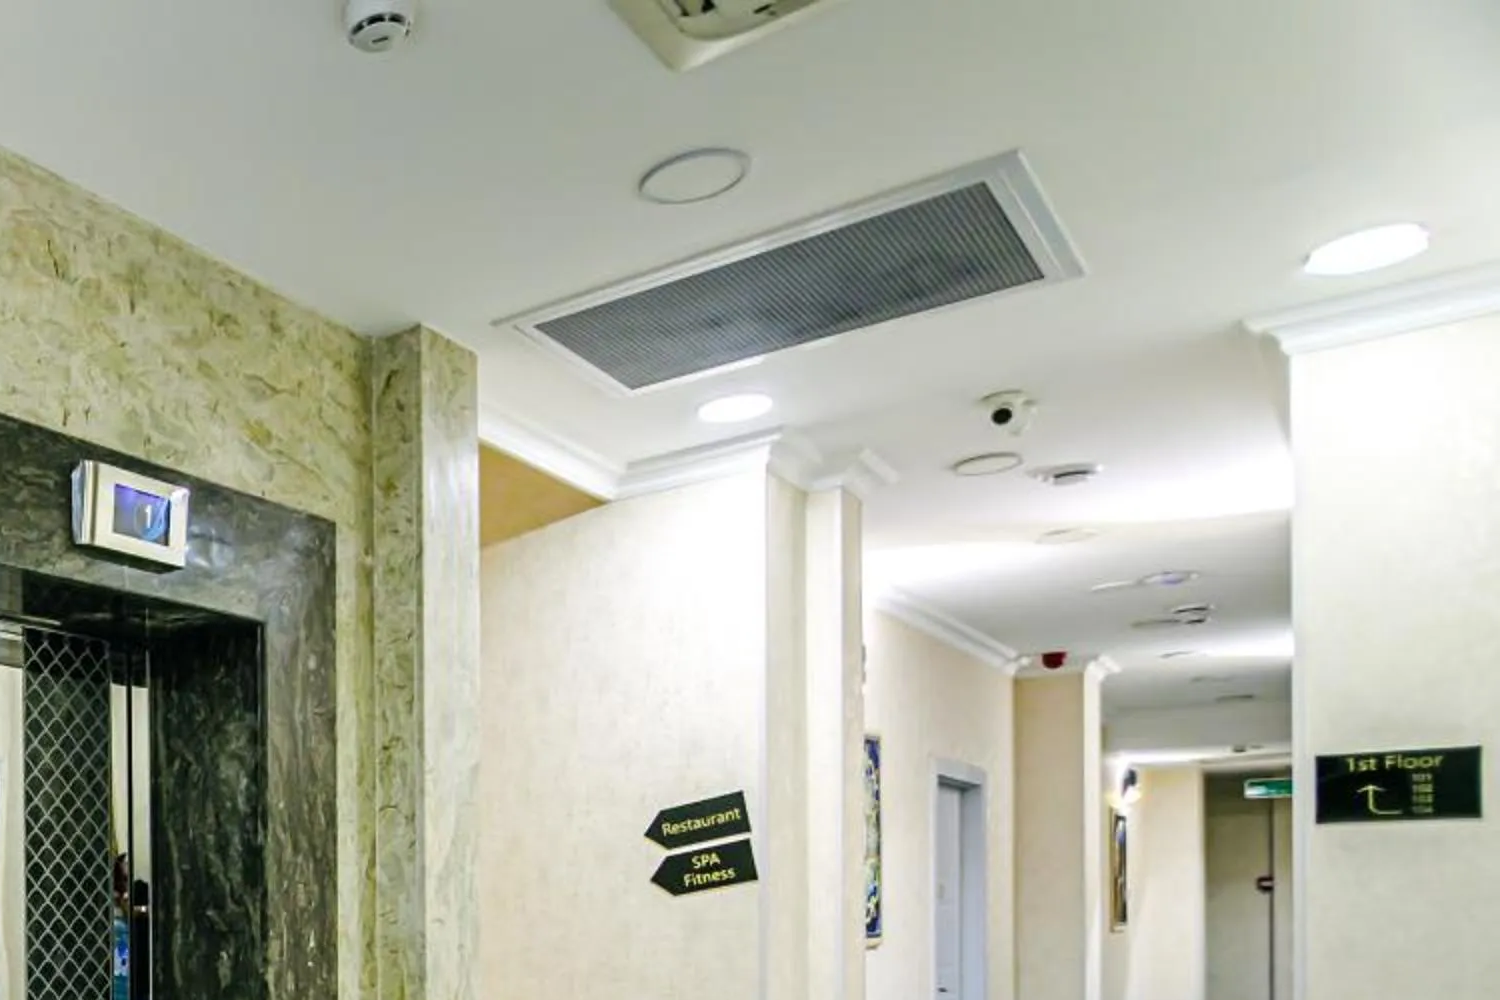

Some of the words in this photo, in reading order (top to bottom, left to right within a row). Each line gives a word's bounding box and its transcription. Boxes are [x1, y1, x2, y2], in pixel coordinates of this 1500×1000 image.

[145, 504, 152, 529] 1
[1346, 757, 1378, 772] 1st
[1385, 754, 1444, 769] Floor
[661, 807, 741, 836] Restaurant
[691, 852, 721, 869] SPA
[683, 868, 736, 887] Fitness
